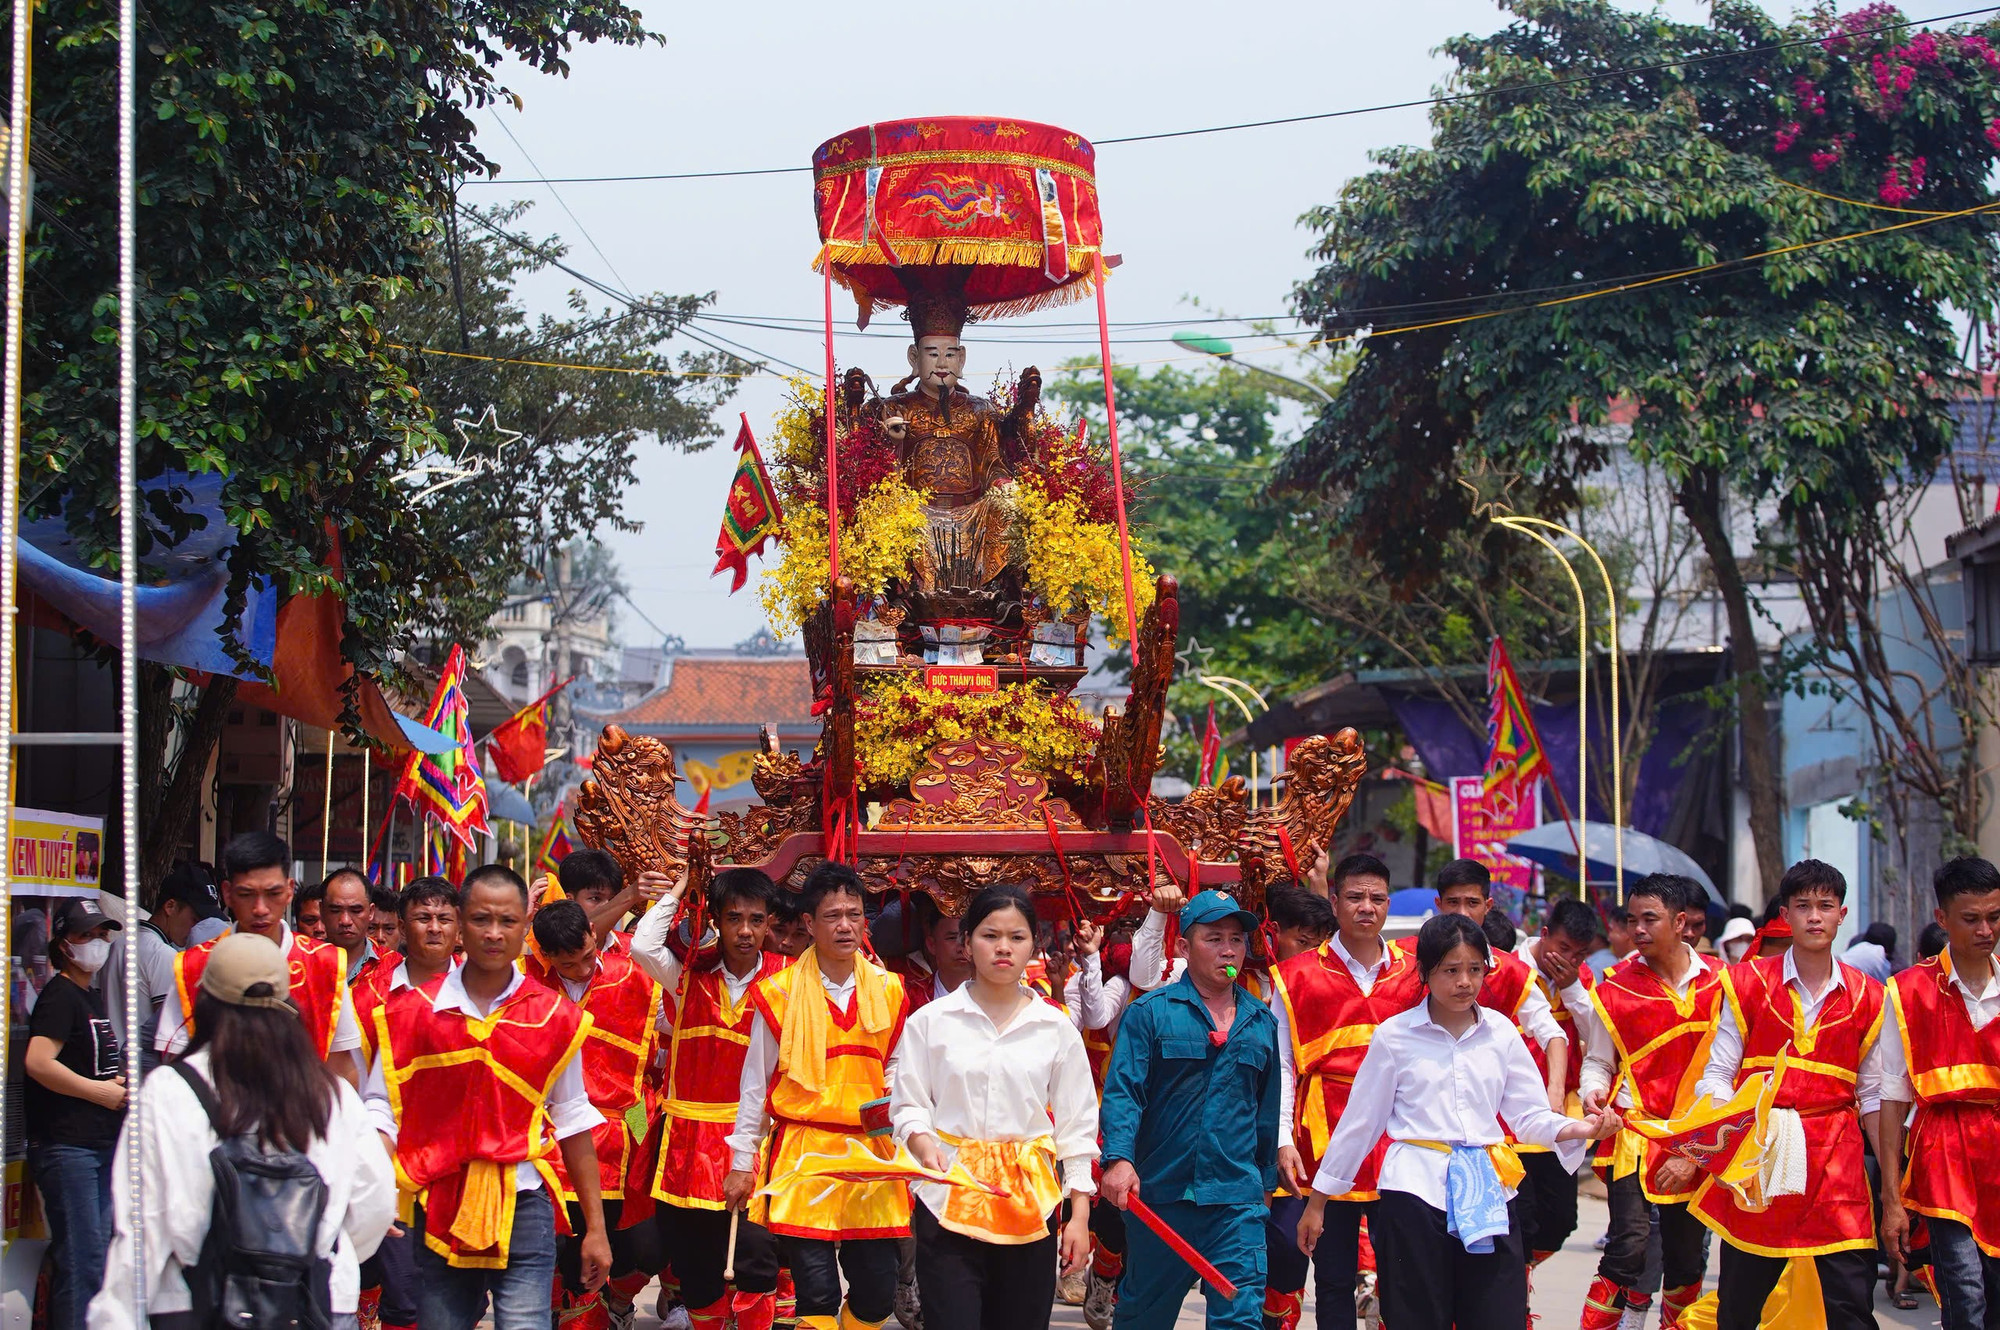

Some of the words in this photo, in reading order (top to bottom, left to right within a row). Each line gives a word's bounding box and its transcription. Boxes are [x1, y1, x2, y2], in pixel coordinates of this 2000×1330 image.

[932, 671, 948, 686] ĐỨC
[976, 673, 992, 686] ÔNG
[39, 829, 74, 880] TUYẾT
